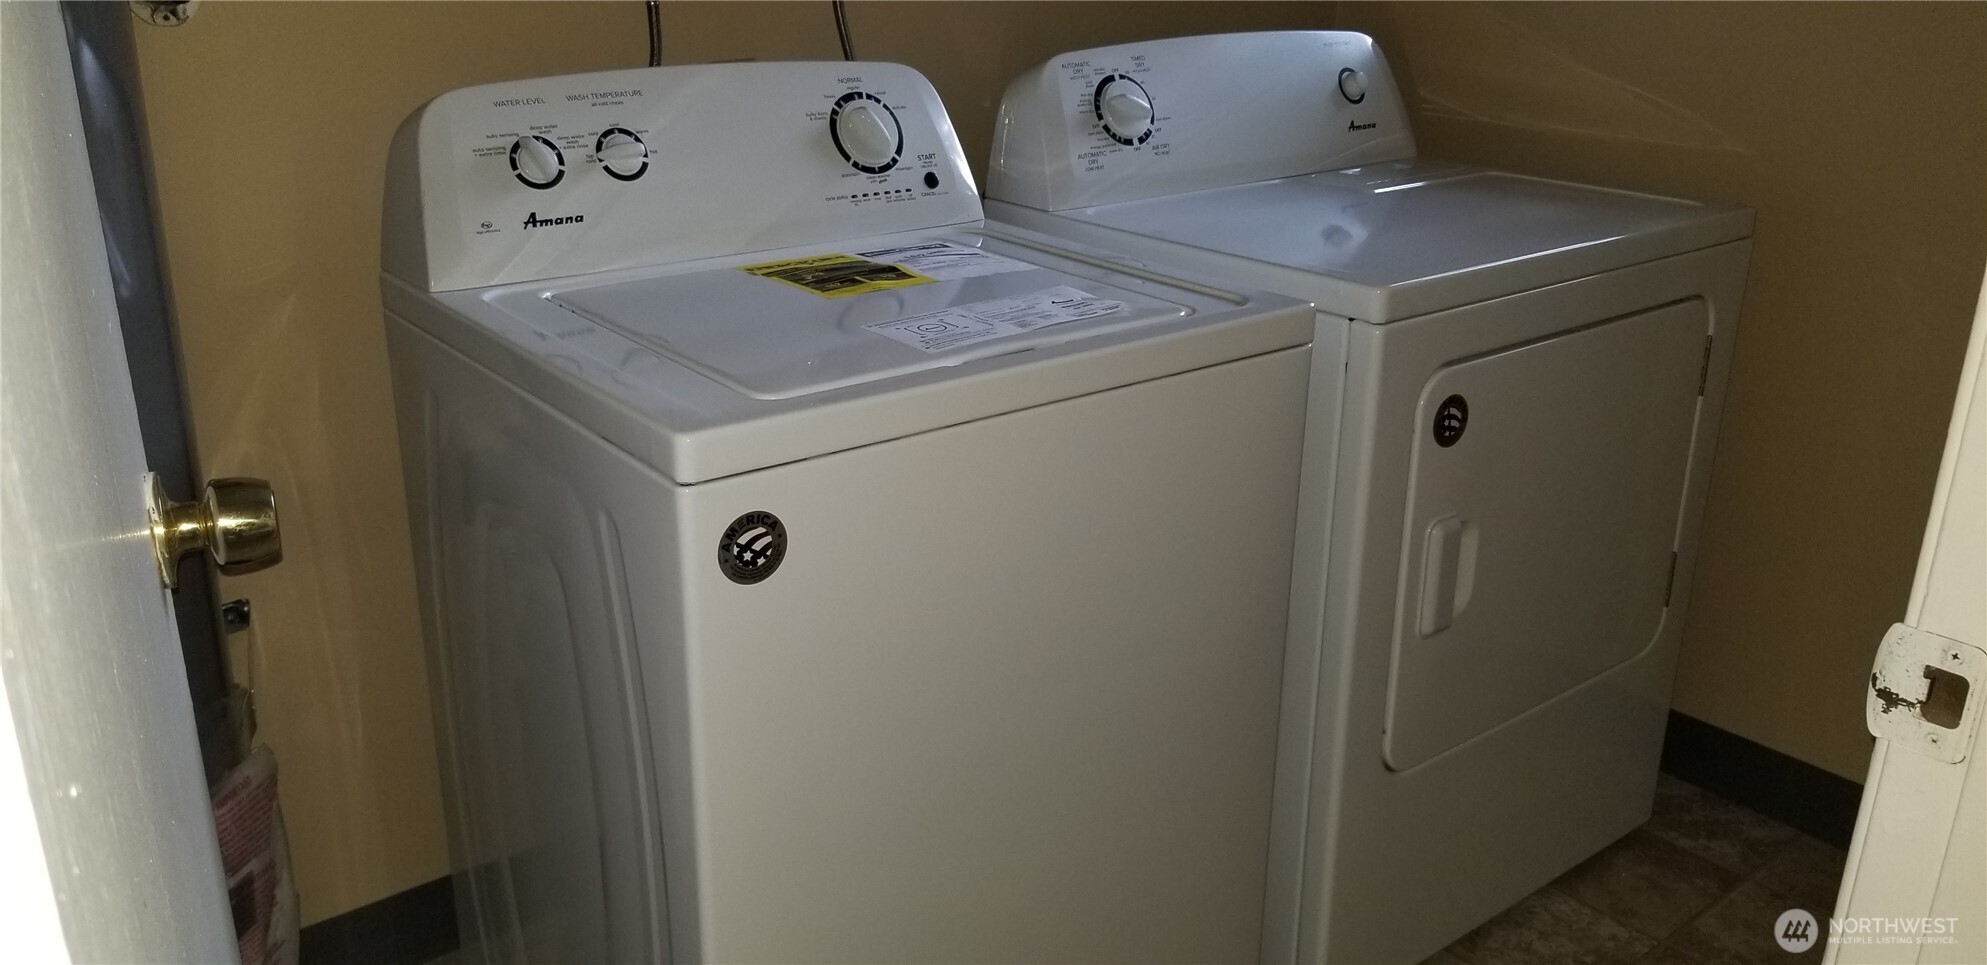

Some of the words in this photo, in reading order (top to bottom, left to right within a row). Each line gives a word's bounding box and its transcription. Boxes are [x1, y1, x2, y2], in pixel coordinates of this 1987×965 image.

[566, 94, 589, 102] WASH
[591, 90, 643, 99] TEMPERATURE
[493, 99, 520, 108] WATER
[522, 97, 546, 106] LEVEL
[1348, 120, 1376, 132] Amana
[917, 153, 936, 161] START
[1077, 150, 1107, 160] AUTOMATIC
[523, 211, 584, 230] Amana
[722, 514, 778, 553] AMERICA
